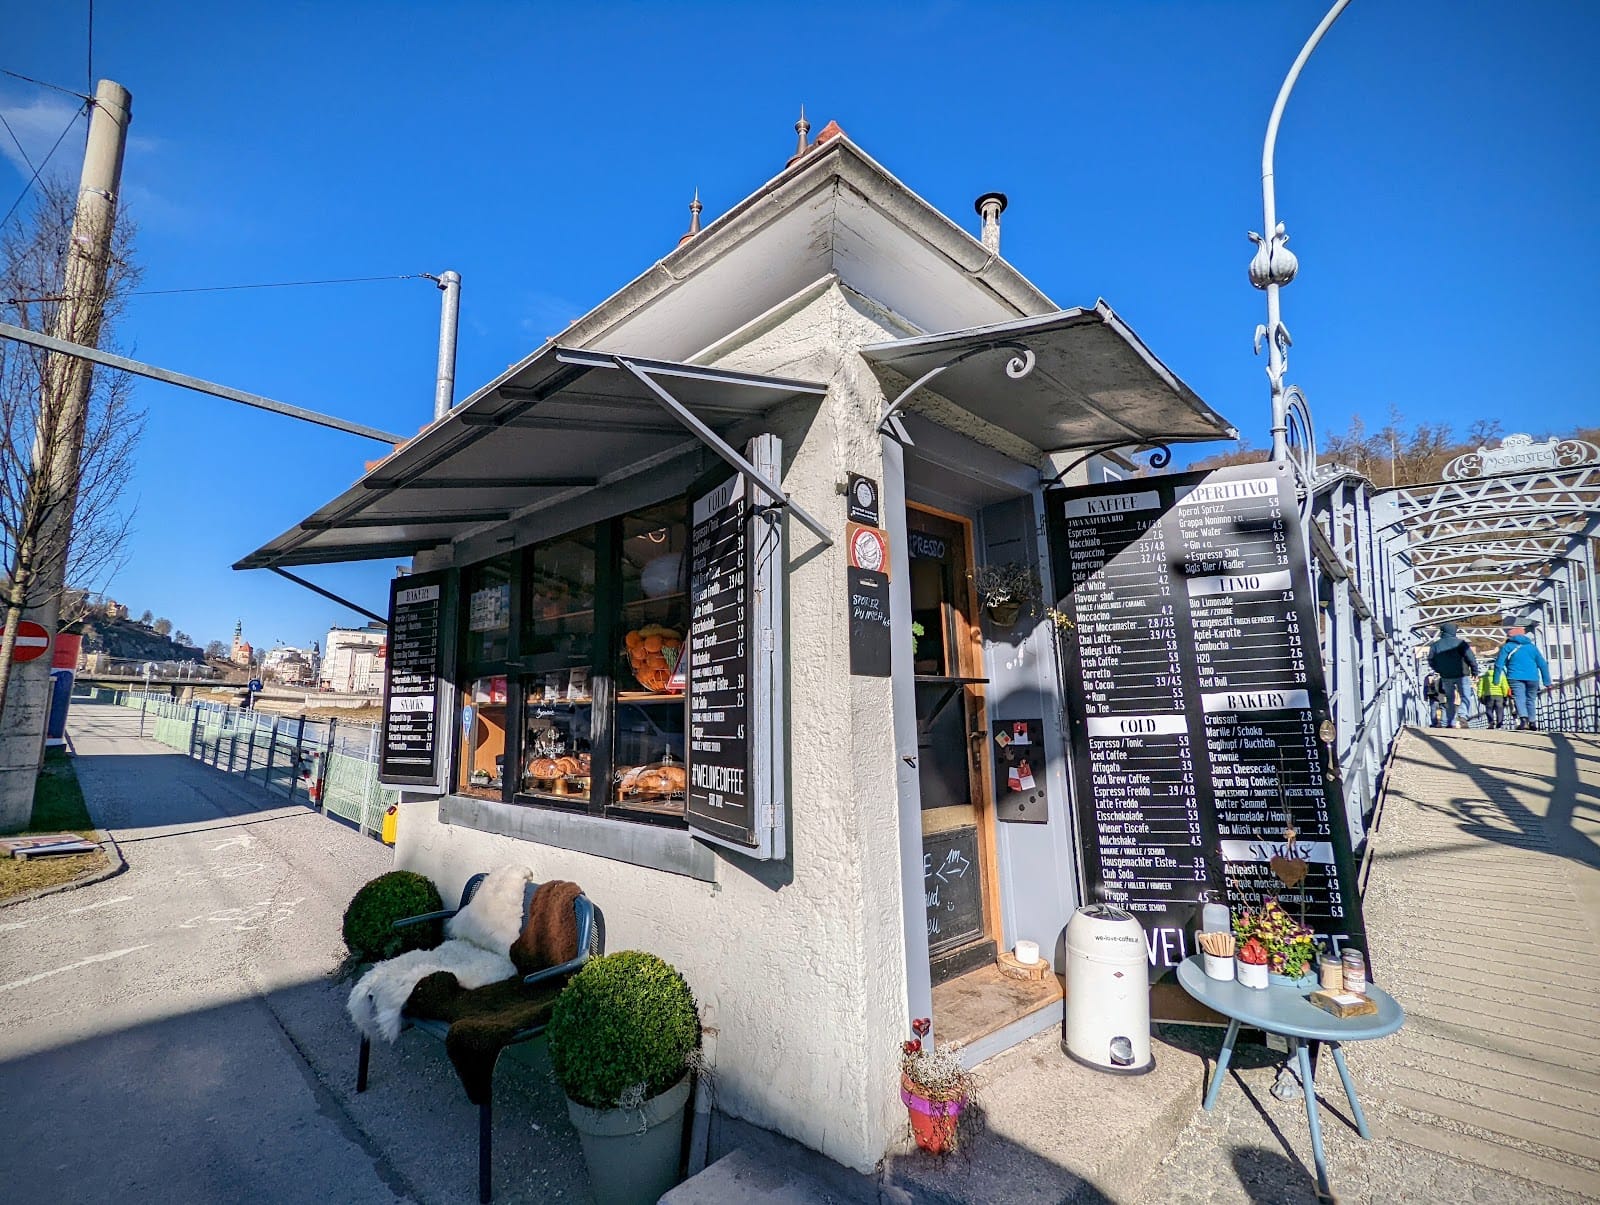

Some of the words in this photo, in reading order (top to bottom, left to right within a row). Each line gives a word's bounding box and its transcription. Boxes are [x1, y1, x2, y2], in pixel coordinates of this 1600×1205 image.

[1187, 481, 1269, 502] APERITIVO
[1088, 496, 1137, 514] KAFFEE
[1179, 506, 1200, 518] Aperol
[1269, 498, 1279, 507] 5.9
[1179, 519, 1203, 528] Grappa
[1271, 509, 1281, 518] 4.5
[1068, 528, 1096, 539] Espresso
[1181, 530, 1198, 539] Tonic
[1201, 528, 1222, 536] Water
[1272, 521, 1282, 530] 4.5
[1274, 532, 1284, 541] 8.5
[1069, 538, 1100, 548] Macchiato
[1070, 549, 1105, 560] Cappuccino
[1140, 544, 1149, 552] 3.5
[1155, 542, 1164, 551] 4.8
[1191, 551, 1222, 562] Espresso
[1276, 543, 1286, 553] 9.5
[1072, 560, 1104, 571] Americano
[1202, 562, 1216, 571] Bier
[1223, 560, 1245, 569] Radler
[1277, 555, 1288, 565] 3.8
[1087, 582, 1106, 591] White
[1220, 576, 1260, 592] LIMO
[1075, 594, 1098, 603] Flavour
[1100, 591, 1114, 601] shot
[1189, 599, 1199, 608] Bio
[1202, 596, 1233, 607] Limonade
[1283, 591, 1294, 601] 2.9
[1076, 612, 1110, 622] Moccacino
[1162, 606, 1173, 615] 4.2
[1192, 617, 1233, 628] Orangensaft
[1286, 611, 1297, 621] 4.5
[1096, 622, 1137, 632] Moccamaster
[1194, 628, 1241, 641] Apfel-Karotte
[1288, 624, 1299, 634] 4.8
[1079, 635, 1092, 644] Chai
[1094, 634, 1111, 643] Latte
[1195, 641, 1229, 651] Kombucha
[1289, 636, 1301, 646] 2.9
[1080, 647, 1102, 656] Baileys
[1104, 645, 1121, 654] Latte
[1167, 641, 1177, 650] 5.8
[1291, 648, 1302, 658] 2.6
[1081, 658, 1096, 668] Irish
[1098, 657, 1118, 666] Coffee
[1169, 652, 1178, 661] 5.9
[1082, 670, 1111, 678] Corretto
[1170, 664, 1180, 673] 4.5
[1198, 666, 1214, 675] Limo
[1292, 660, 1304, 670] 2.6
[1083, 682, 1093, 690] Bio
[1095, 681, 1114, 689] Cocoa
[1200, 678, 1212, 687] Red
[1215, 677, 1227, 686] Bull
[1295, 673, 1306, 683] 3.8
[1173, 688, 1183, 697] 5.5
[1086, 704, 1095, 713] Bio
[1098, 704, 1109, 712] Tee
[1174, 700, 1185, 709] 3.5
[1227, 693, 1286, 708] BAKERY
[1204, 714, 1238, 725] Croissant
[1300, 712, 1312, 721] 2.8
[1120, 719, 1156, 733] COLD
[1206, 727, 1230, 737] Marille
[1238, 726, 1262, 736] Schoko
[1303, 724, 1314, 734] 2.9
[1089, 739, 1119, 749] Espresso
[1179, 736, 1189, 746] 5.9
[1208, 738, 1238, 751] Guglhupf
[1244, 738, 1275, 748] Buchteln
[1305, 737, 1316, 746] 2.5
[1091, 751, 1104, 760] Iced
[1106, 750, 1127, 760] Coffee
[1180, 748, 1190, 758] 4.5
[1208, 752, 1239, 762] Brownie
[1307, 750, 1318, 760] 2.9
[1092, 762, 1120, 773] Affogato
[1182, 761, 1192, 771] 3.9
[1211, 764, 1231, 775] Janas
[1233, 764, 1276, 774] Cheesecake
[1310, 762, 1320, 772] 3.5
[692, 764, 744, 795] #WELOVECOFFEE
[1093, 775, 1106, 784] Cold
[1108, 775, 1126, 784] Brew
[1129, 774, 1150, 784] Coffee
[1183, 773, 1193, 783] 4.5
[1212, 777, 1234, 788] Byron
[1236, 777, 1249, 788] Bay
[1251, 777, 1279, 786] Cookies
[1311, 775, 1322, 786] 2.9
[1094, 786, 1125, 798] Espresso
[1127, 786, 1150, 796] Freddo
[1169, 786, 1178, 795] 3.9
[1184, 786, 1195, 795] 4.8
[1095, 799, 1113, 809] Latte
[1115, 799, 1138, 808] Freddo
[1186, 798, 1197, 808] 4.8
[1215, 799, 1239, 809] Butter
[1241, 799, 1267, 808] Semmel
[1316, 798, 1326, 808] 1.5
[1096, 811, 1143, 821] Eisschokolade
[1188, 810, 1198, 820] 5.9
[1225, 812, 1264, 821] Marmelade
[1317, 811, 1328, 821] 1.8
[1098, 823, 1122, 833] Wiener
[1190, 823, 1200, 833] 5.9
[1218, 824, 1230, 835] Bio
[1318, 824, 1330, 835] 2.5
[1099, 835, 1136, 846] Milchshake
[1190, 836, 1201, 846] 4.5
[1101, 856, 1152, 868] Hausgemachter
[1155, 857, 1176, 867] Eistee
[1193, 857, 1204, 868] 3.9
[1102, 869, 1116, 879] Club
[1118, 869, 1134, 879] Soda
[1195, 870, 1206, 881] 2.5
[1224, 864, 1258, 876] Antipasti
[1325, 866, 1337, 876] 5.9
[1225, 877, 1251, 889] Crque
[1328, 879, 1339, 889] 4.9
[1105, 890, 1128, 902] Frappe
[1198, 892, 1209, 903] 4.5
[1329, 893, 1341, 903] 5.9
[1331, 906, 1343, 917] 6.9
